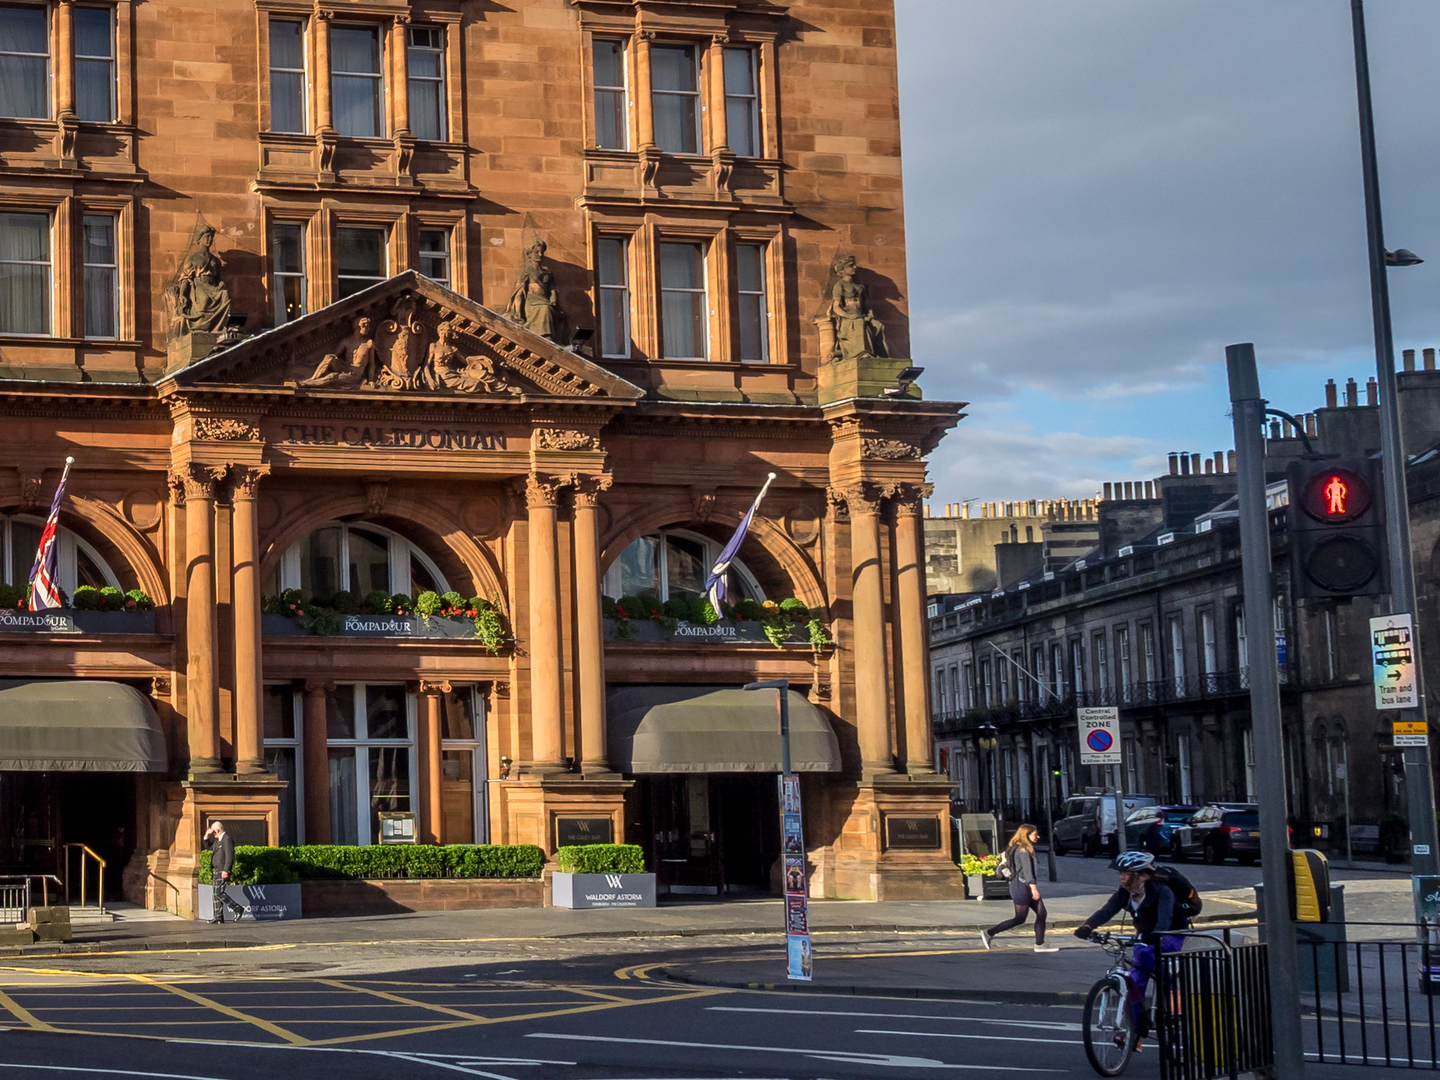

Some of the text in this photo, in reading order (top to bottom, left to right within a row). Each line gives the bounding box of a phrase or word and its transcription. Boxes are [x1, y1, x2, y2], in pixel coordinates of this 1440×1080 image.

[281, 423, 508, 451] THE CALEDONIAN
[344, 619, 412, 632] POMPADOUR
[1379, 683, 1413, 694] Tram and
[1381, 695, 1412, 704] bus lane
[260, 904, 288, 912] ASTORIA
